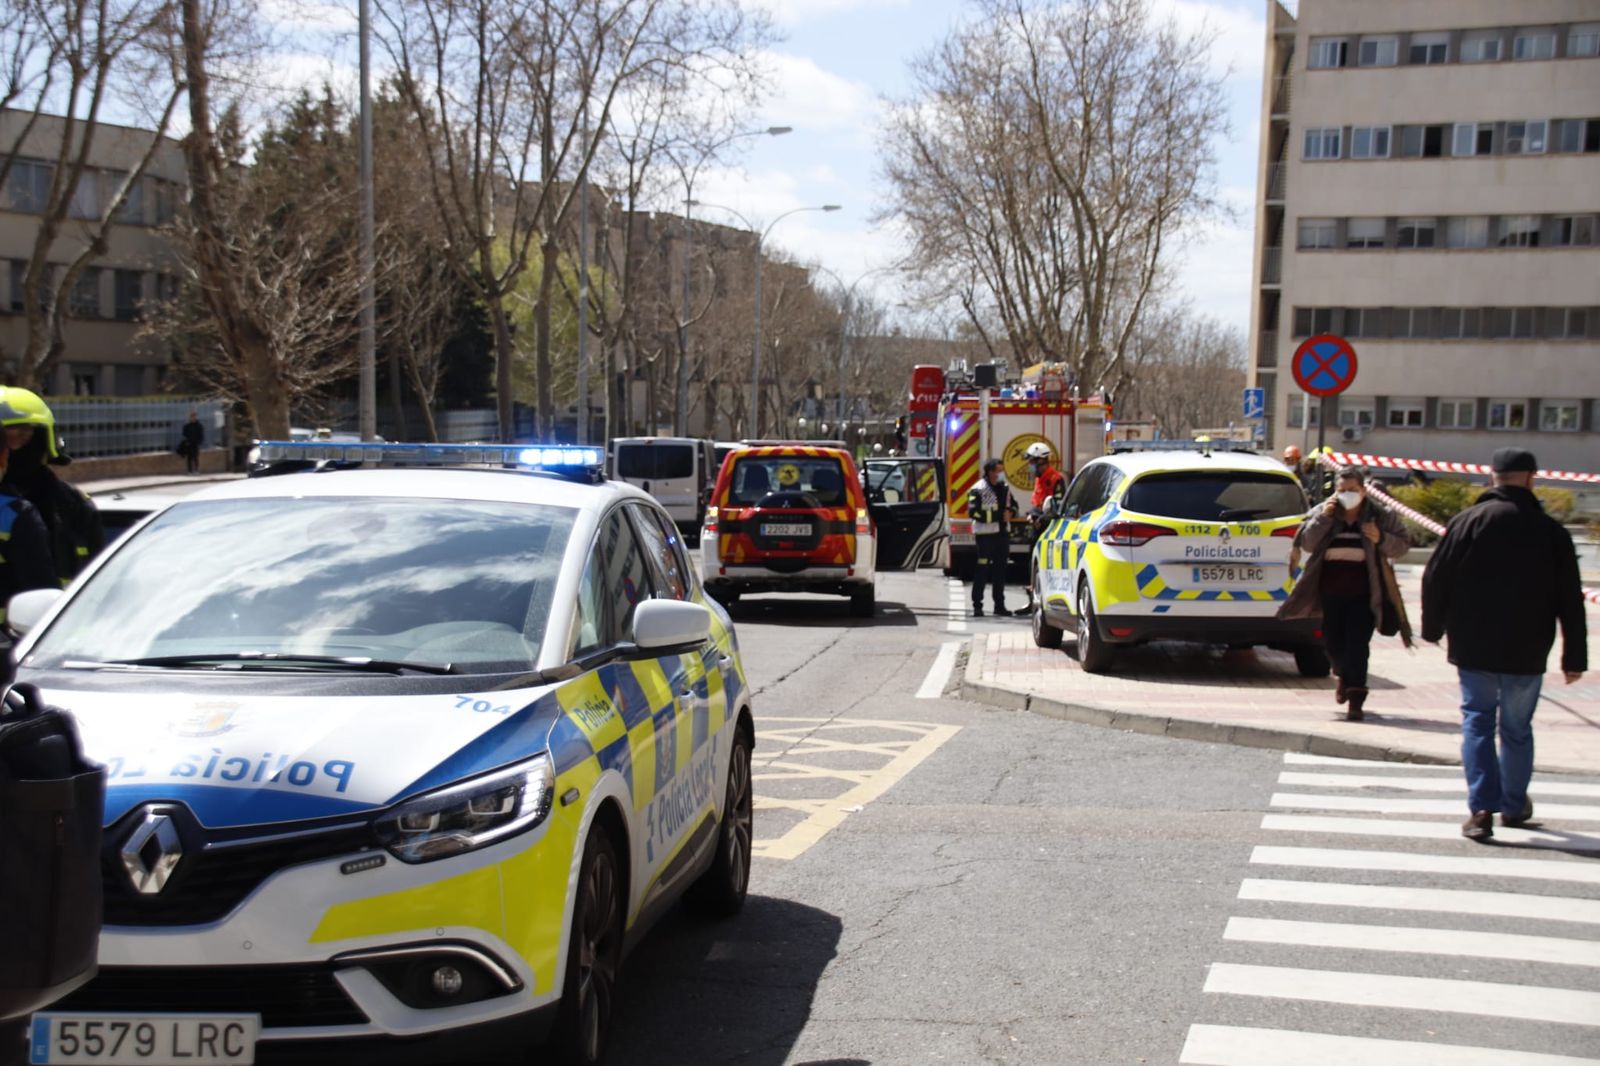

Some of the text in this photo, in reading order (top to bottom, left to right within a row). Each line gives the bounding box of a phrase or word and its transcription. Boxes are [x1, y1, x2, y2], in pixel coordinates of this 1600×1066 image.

[1239, 525, 1260, 535] 700
[1201, 568, 1263, 580] 5578 LRC
[455, 694, 511, 715] 704
[59, 1021, 245, 1057] 5579 LRC
